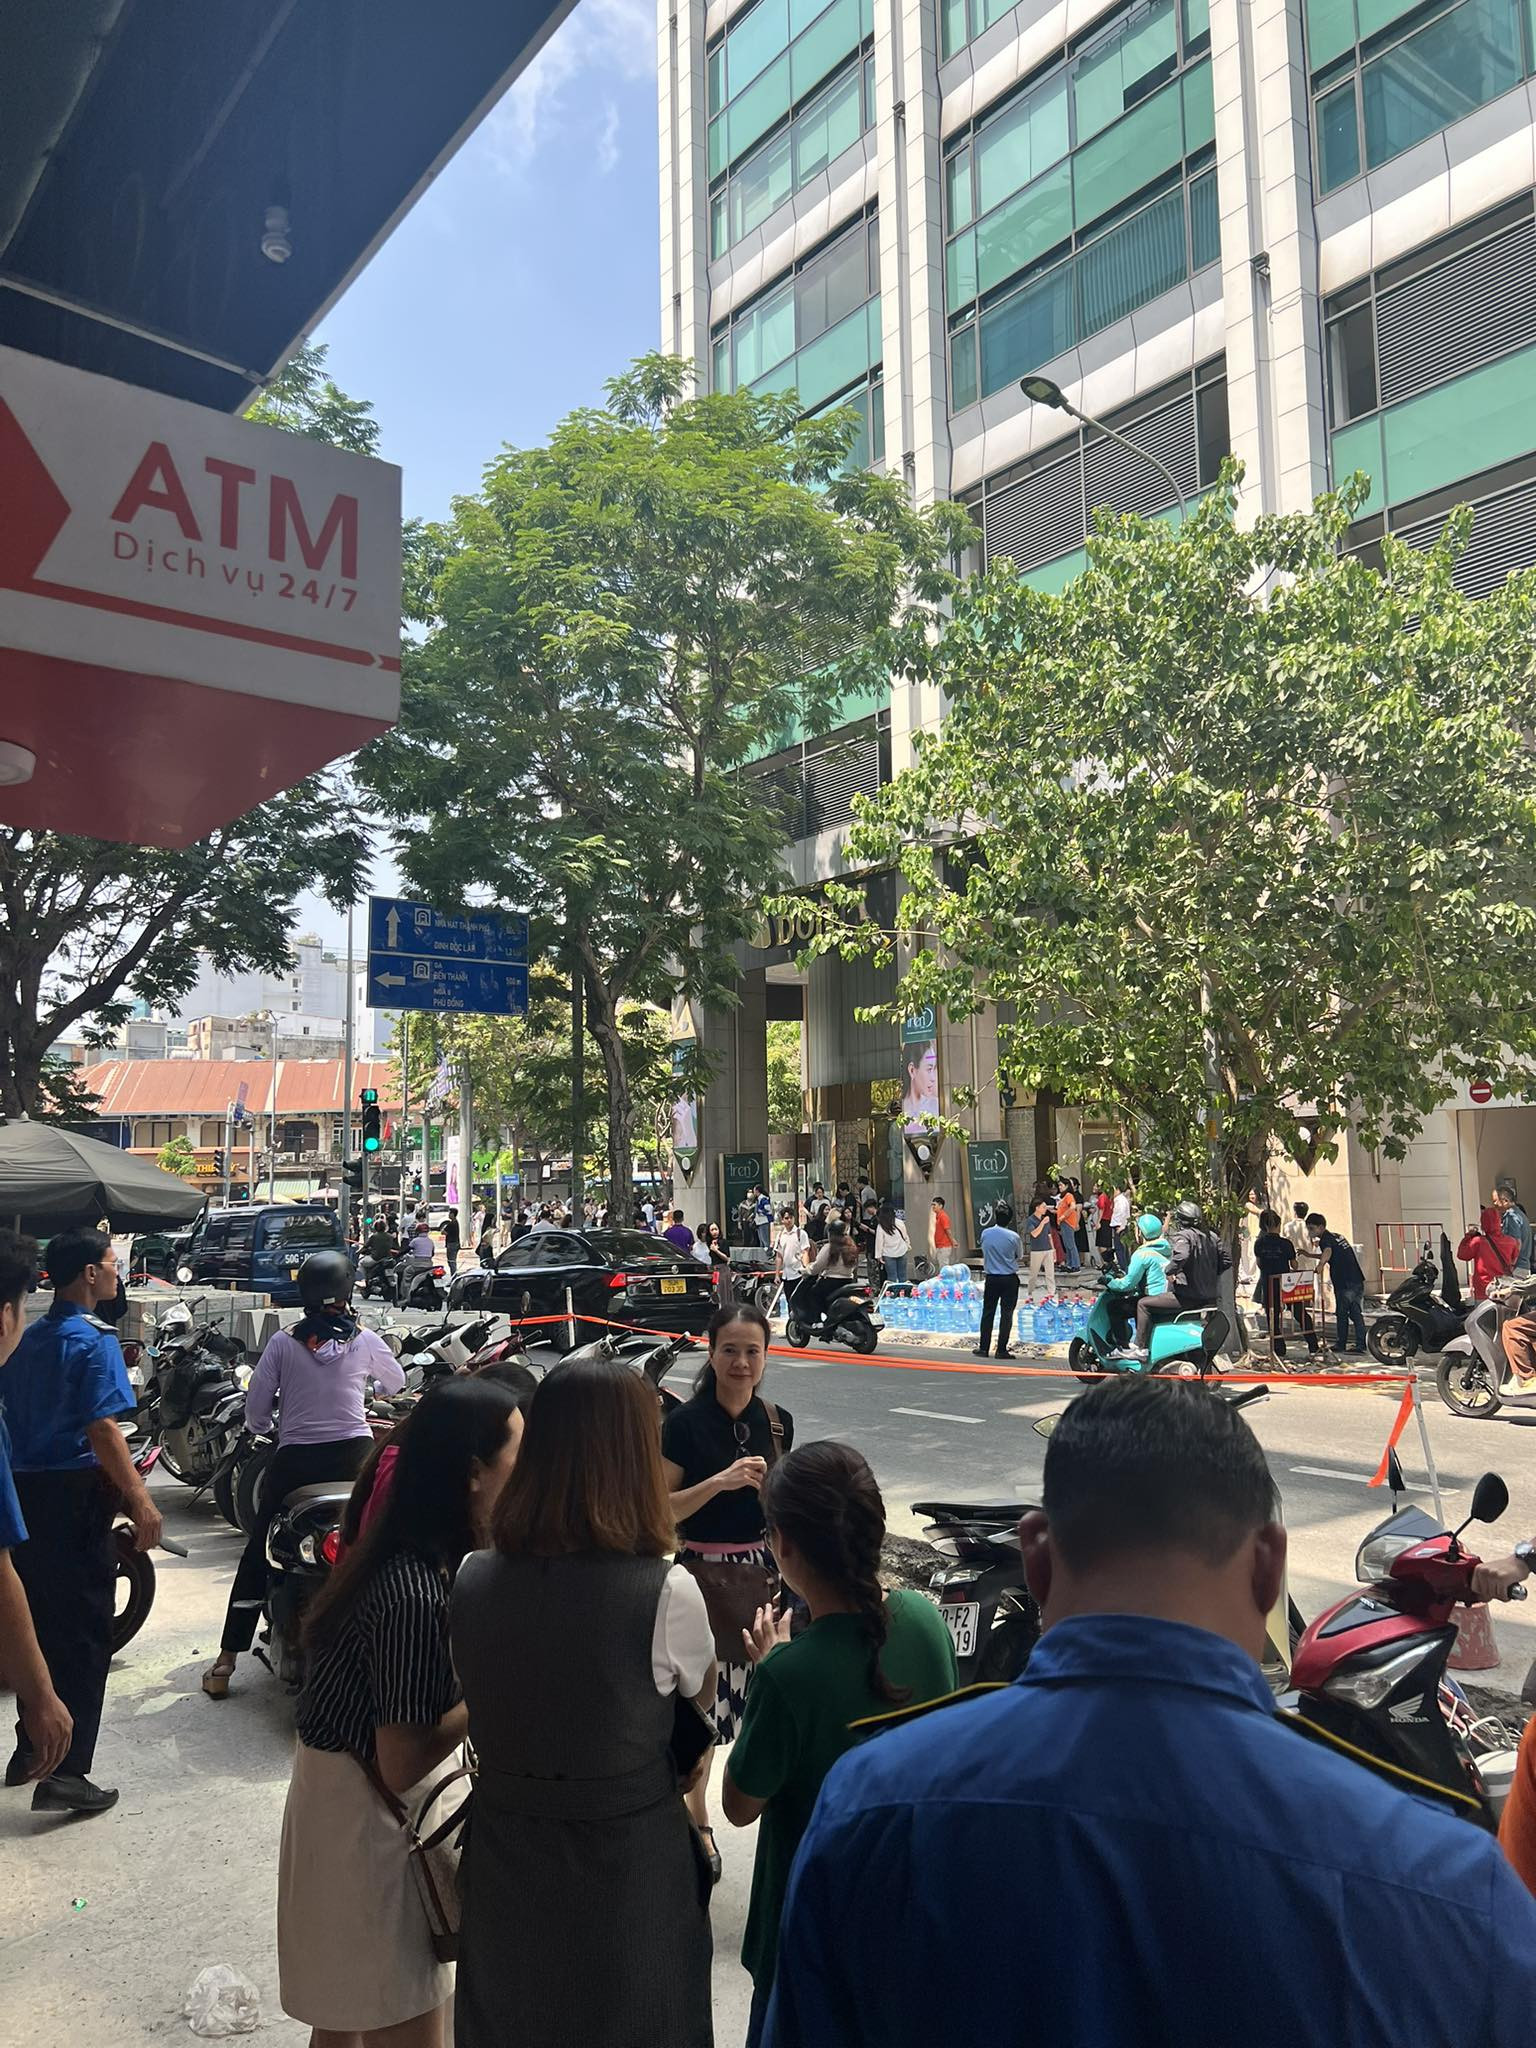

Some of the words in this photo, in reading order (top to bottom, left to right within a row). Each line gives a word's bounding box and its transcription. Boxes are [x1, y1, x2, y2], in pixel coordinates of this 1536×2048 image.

[110, 441, 358, 580] ATM
[113, 532, 204, 578] Dịch
[222, 565, 264, 597] vụ
[278, 573, 358, 612] 24/7
